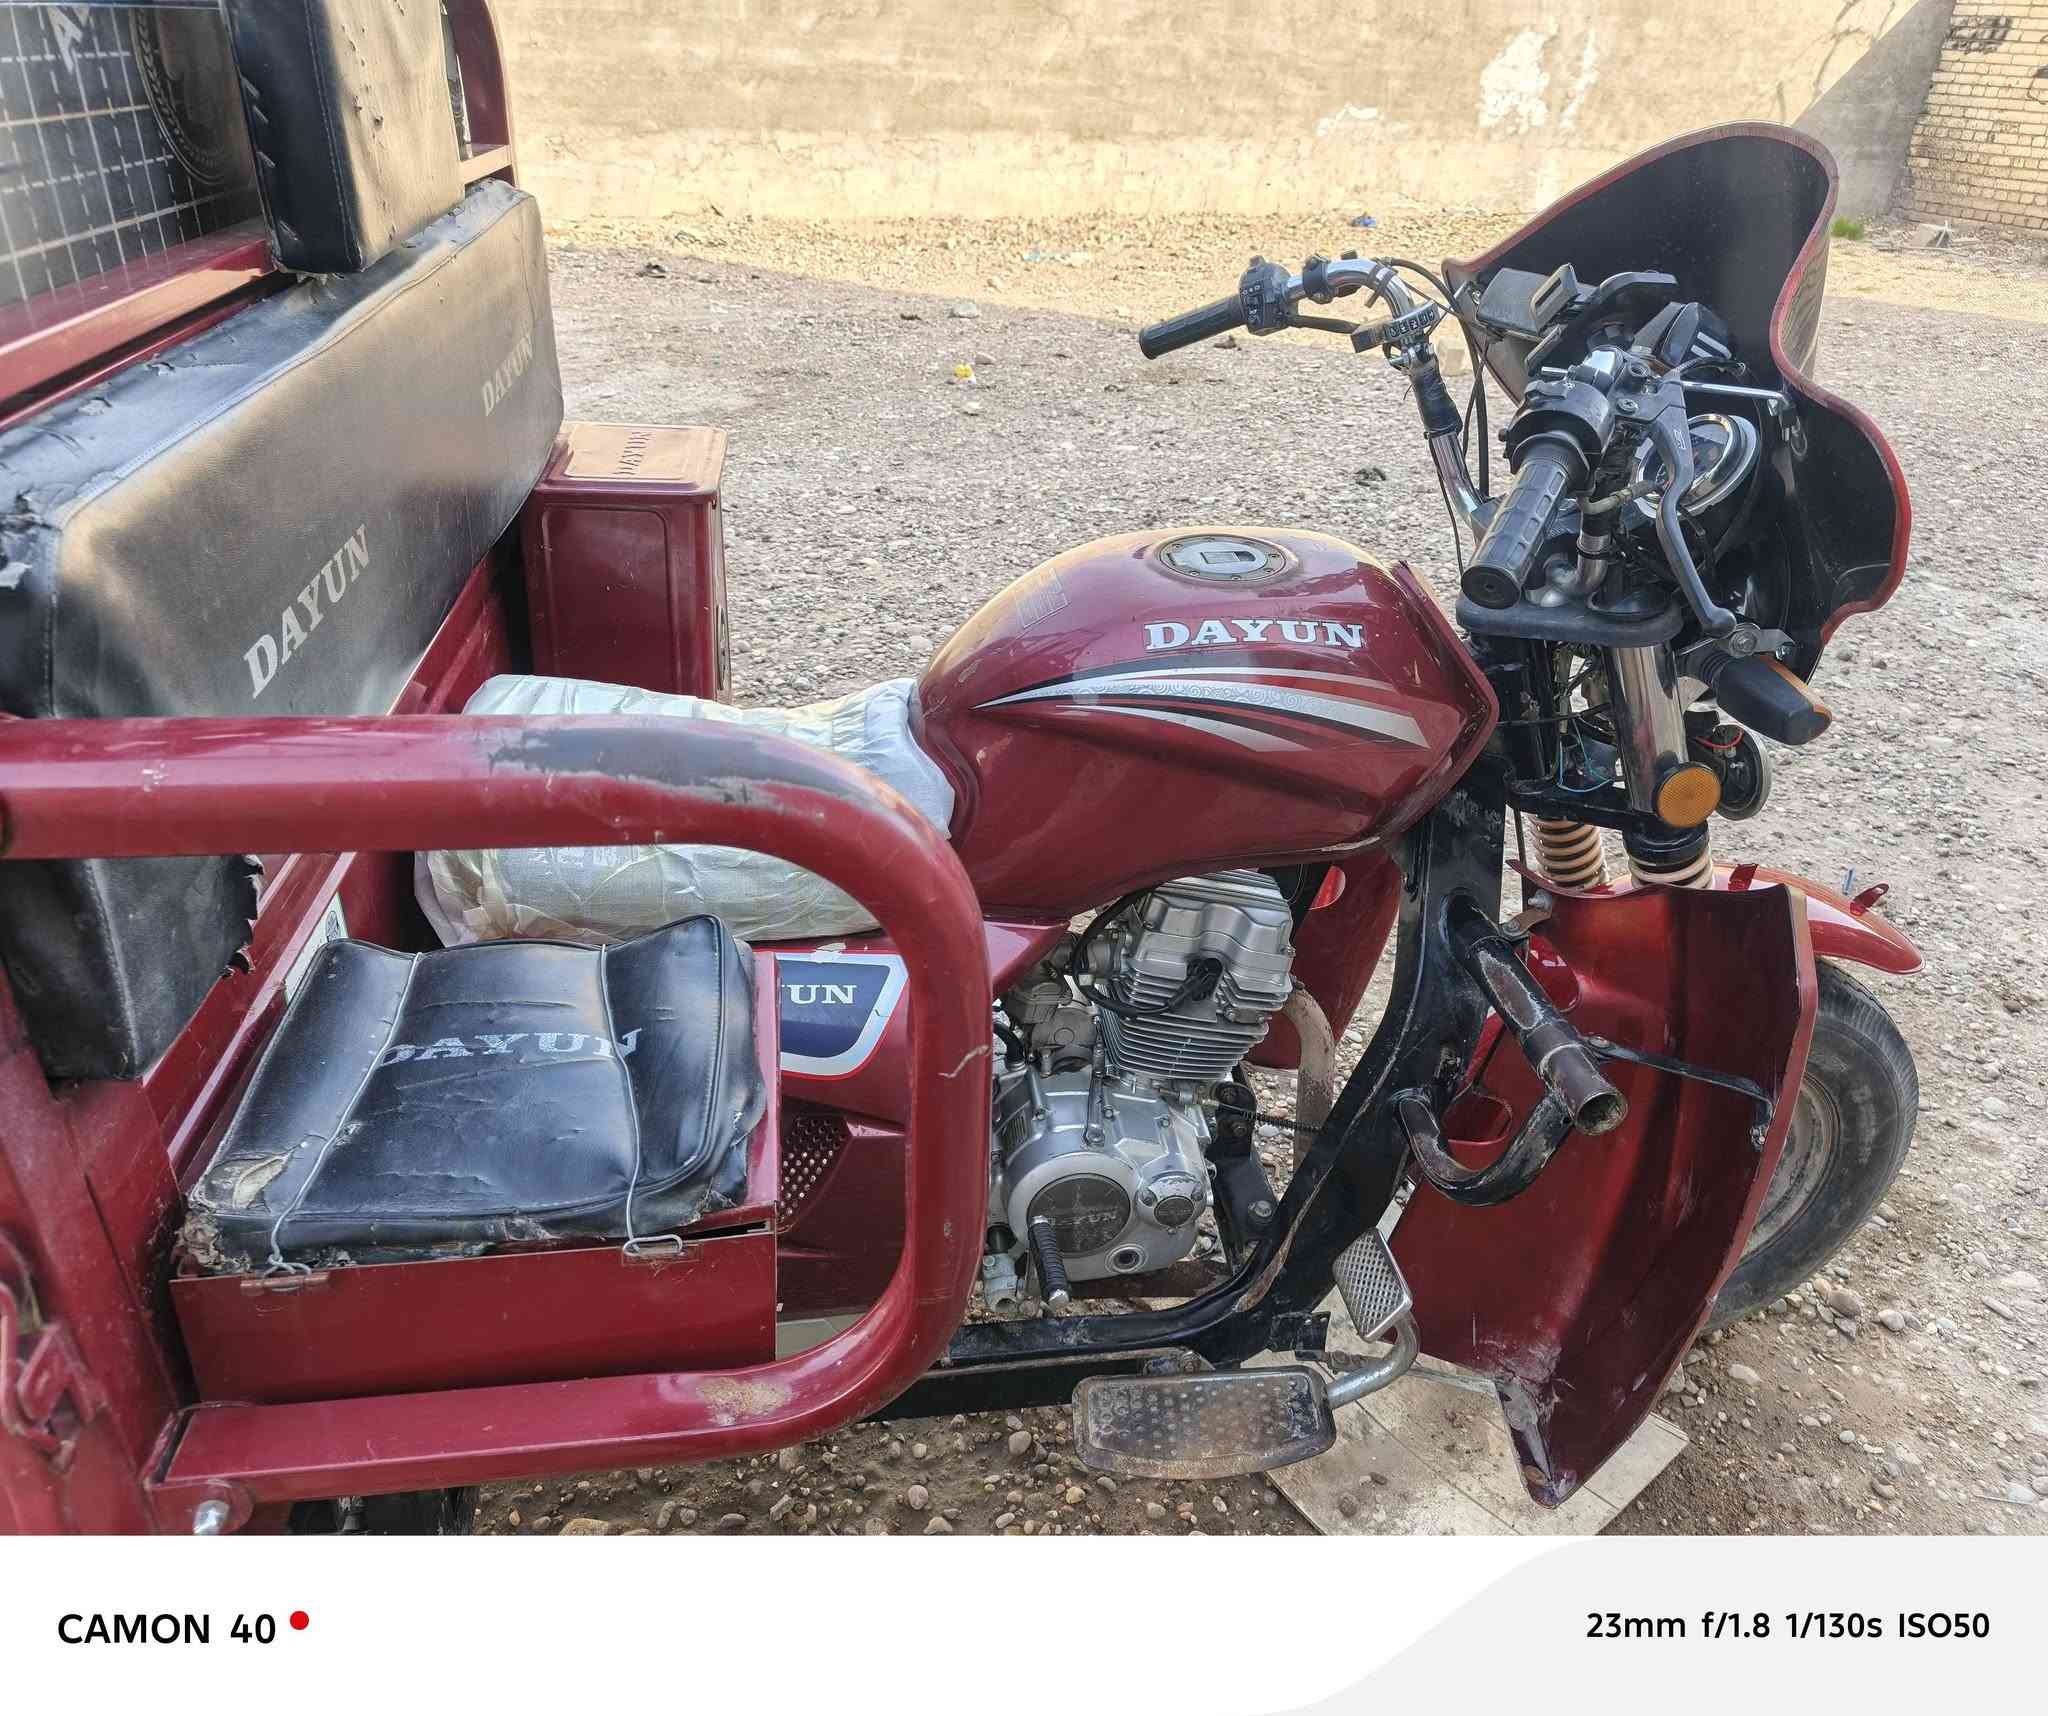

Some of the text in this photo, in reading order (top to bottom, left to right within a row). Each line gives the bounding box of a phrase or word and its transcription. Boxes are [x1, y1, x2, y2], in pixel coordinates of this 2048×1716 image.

[482, 334, 533, 417] DAYUN
[243, 523, 369, 699] DAYUN
[1144, 619, 1363, 650] DAYUN
[781, 984, 857, 1005] UN
[380, 1027, 642, 1067] DAYUN
